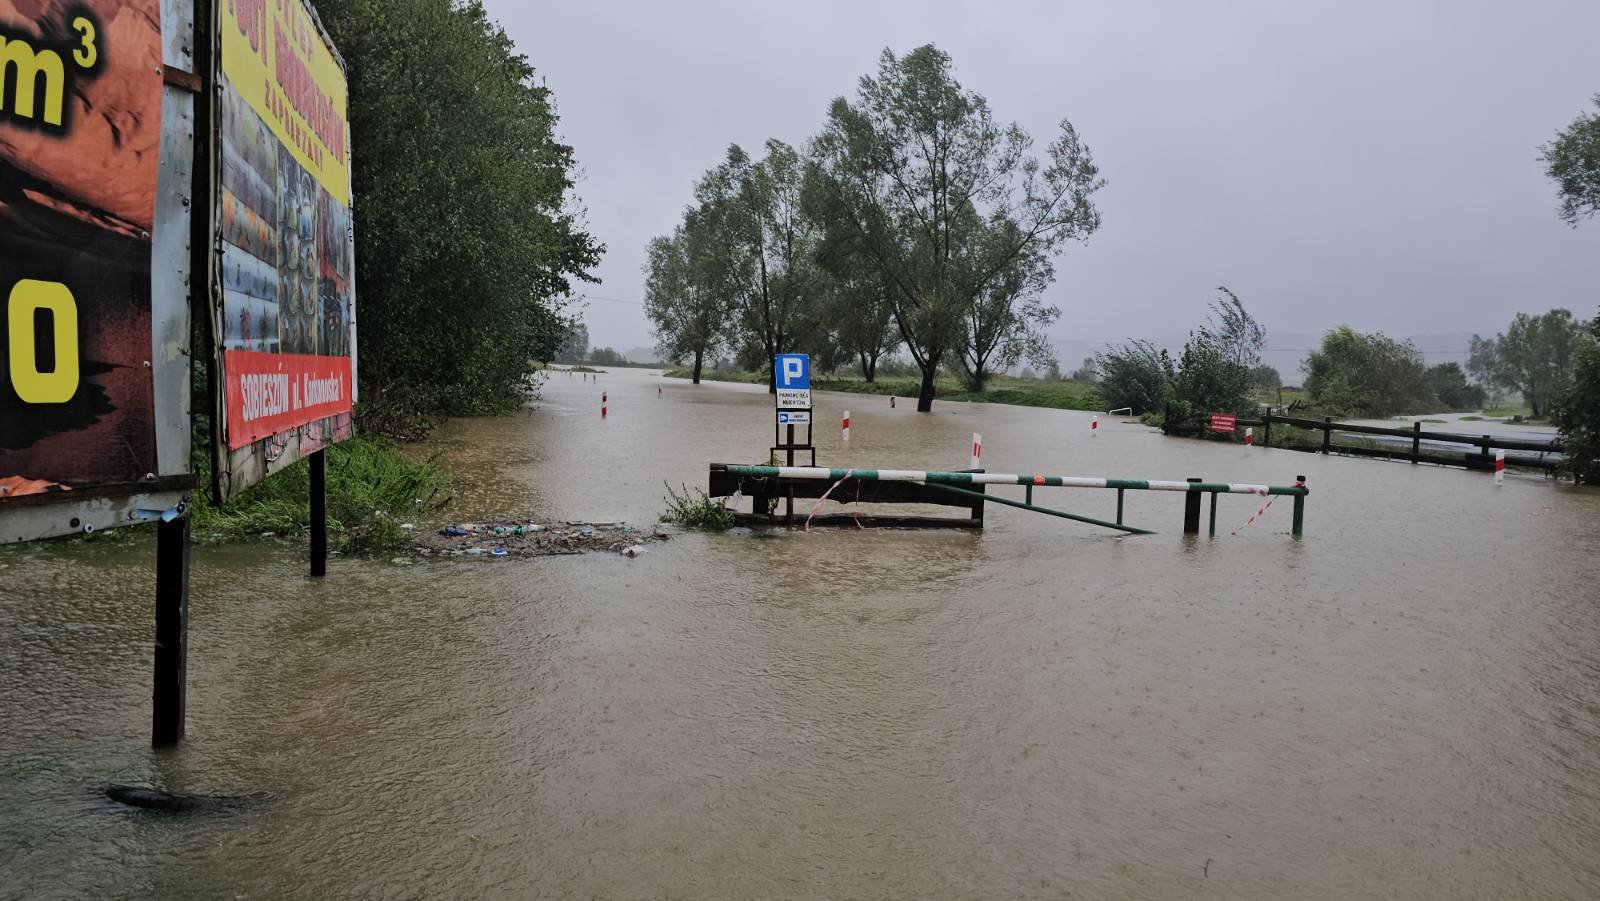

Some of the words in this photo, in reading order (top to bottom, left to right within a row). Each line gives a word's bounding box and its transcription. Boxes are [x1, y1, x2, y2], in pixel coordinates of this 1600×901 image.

[275, 0, 313, 61] KLEP
[240, 362, 289, 422] SOBIESZÓW
[292, 374, 302, 410] ul.
[338, 371, 344, 401] 1
[783, 357, 803, 385] P
